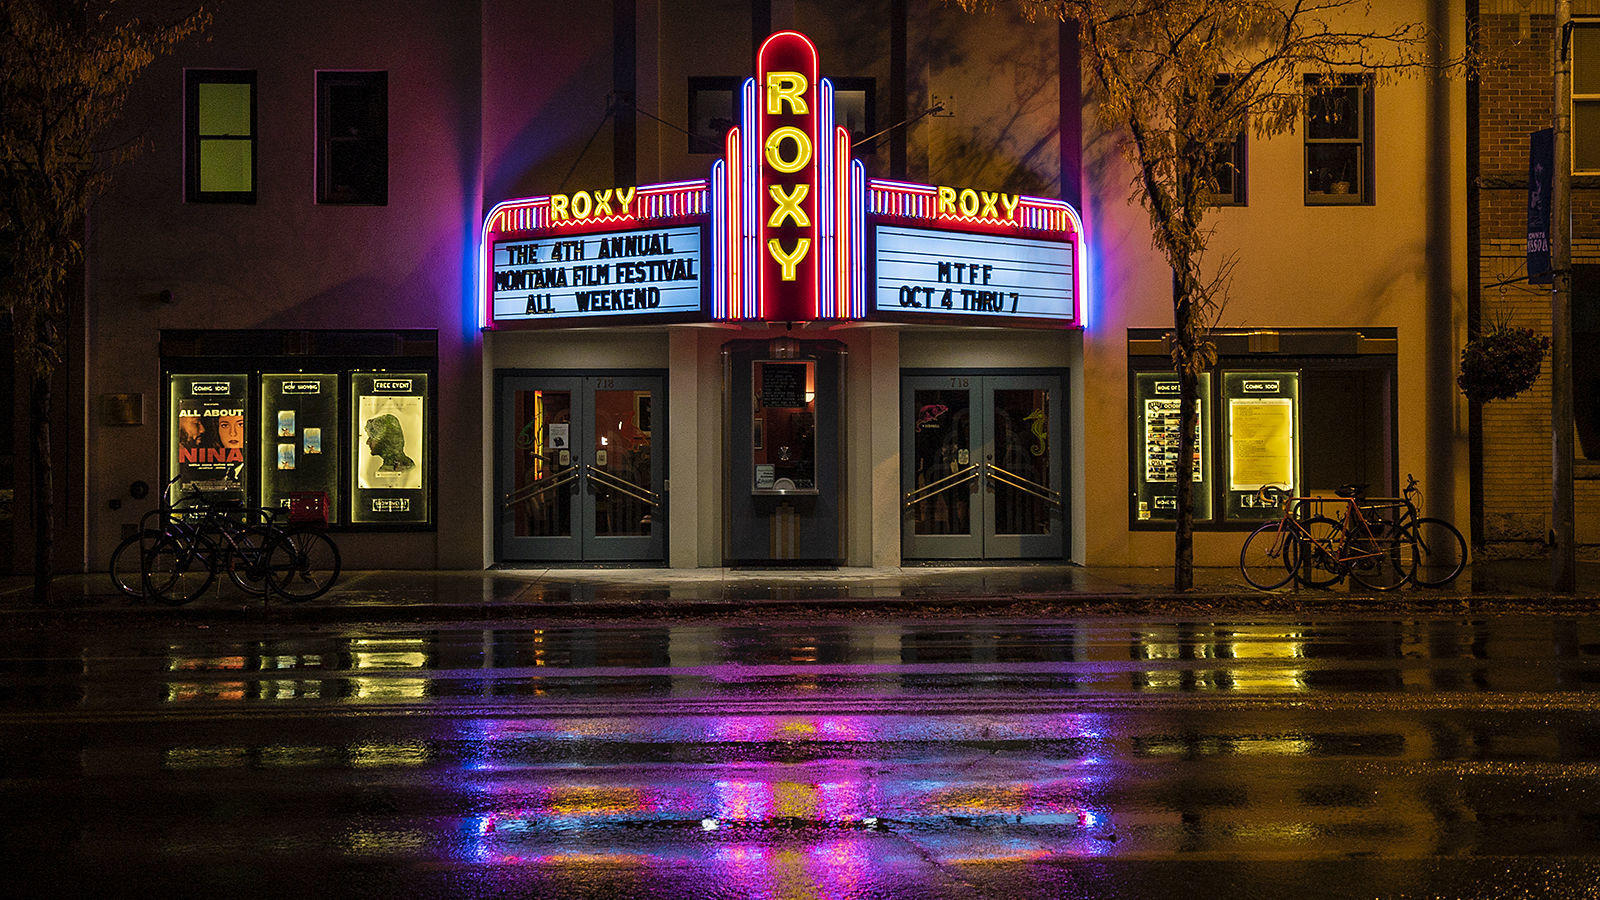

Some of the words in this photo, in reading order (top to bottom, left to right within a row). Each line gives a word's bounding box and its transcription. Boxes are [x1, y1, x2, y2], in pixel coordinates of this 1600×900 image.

[765, 72, 813, 281] ROXY
[551, 186, 636, 221] ROXY
[938, 186, 1020, 220] ROXY
[506, 244, 539, 266] THE
[551, 240, 585, 262] 4TH
[598, 233, 674, 259] ANNUAL
[494, 267, 568, 291] MONTANA
[572, 264, 610, 287] FILM
[615, 258, 699, 284] FESTIVAL
[937, 261, 993, 285] MTFF
[526, 294, 556, 315] ALL
[575, 287, 661, 312] WEEKEND
[899, 285, 935, 309] OCT
[941, 288, 953, 310] 4
[960, 288, 1004, 312] THRU
[1009, 292, 1019, 314] 7
[597, 377, 615, 388] 718
[950, 378, 969, 388] 718
[179, 409, 201, 417] ALL
[203, 408, 244, 417] ABOUT
[179, 447, 244, 463] NINA
